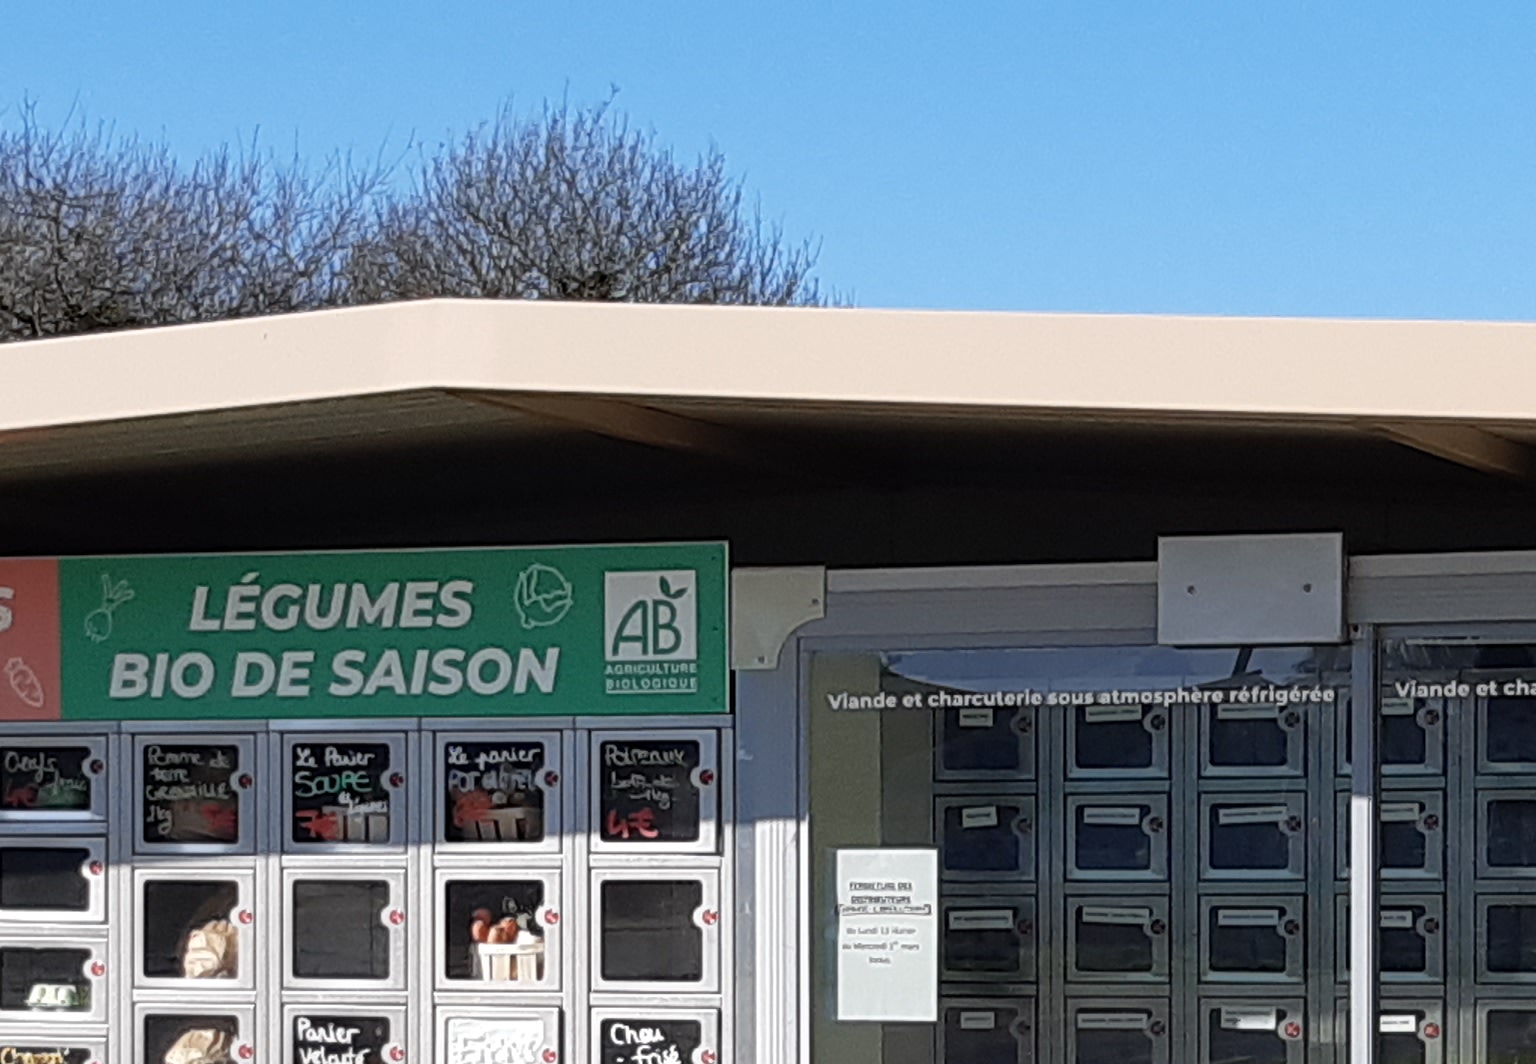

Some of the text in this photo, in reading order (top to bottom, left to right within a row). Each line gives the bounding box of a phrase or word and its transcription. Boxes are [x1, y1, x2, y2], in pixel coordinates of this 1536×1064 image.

[189, 571, 474, 630] LÉGUMES
[612, 599, 682, 656] AB
[109, 646, 560, 698] BIO DE SAISON
[605, 663, 697, 675] AGRICULTURE
[606, 678, 697, 689] BIOLOGIQUE
[1394, 680, 1470, 699] Viande
[1476, 684, 1497, 696] et
[827, 685, 1334, 710] Viande et charcuterie sous atmosphère réfrigérée
[475, 747, 541, 771] panier
[297, 1017, 361, 1044] Panier
[610, 1023, 664, 1045] Chou
